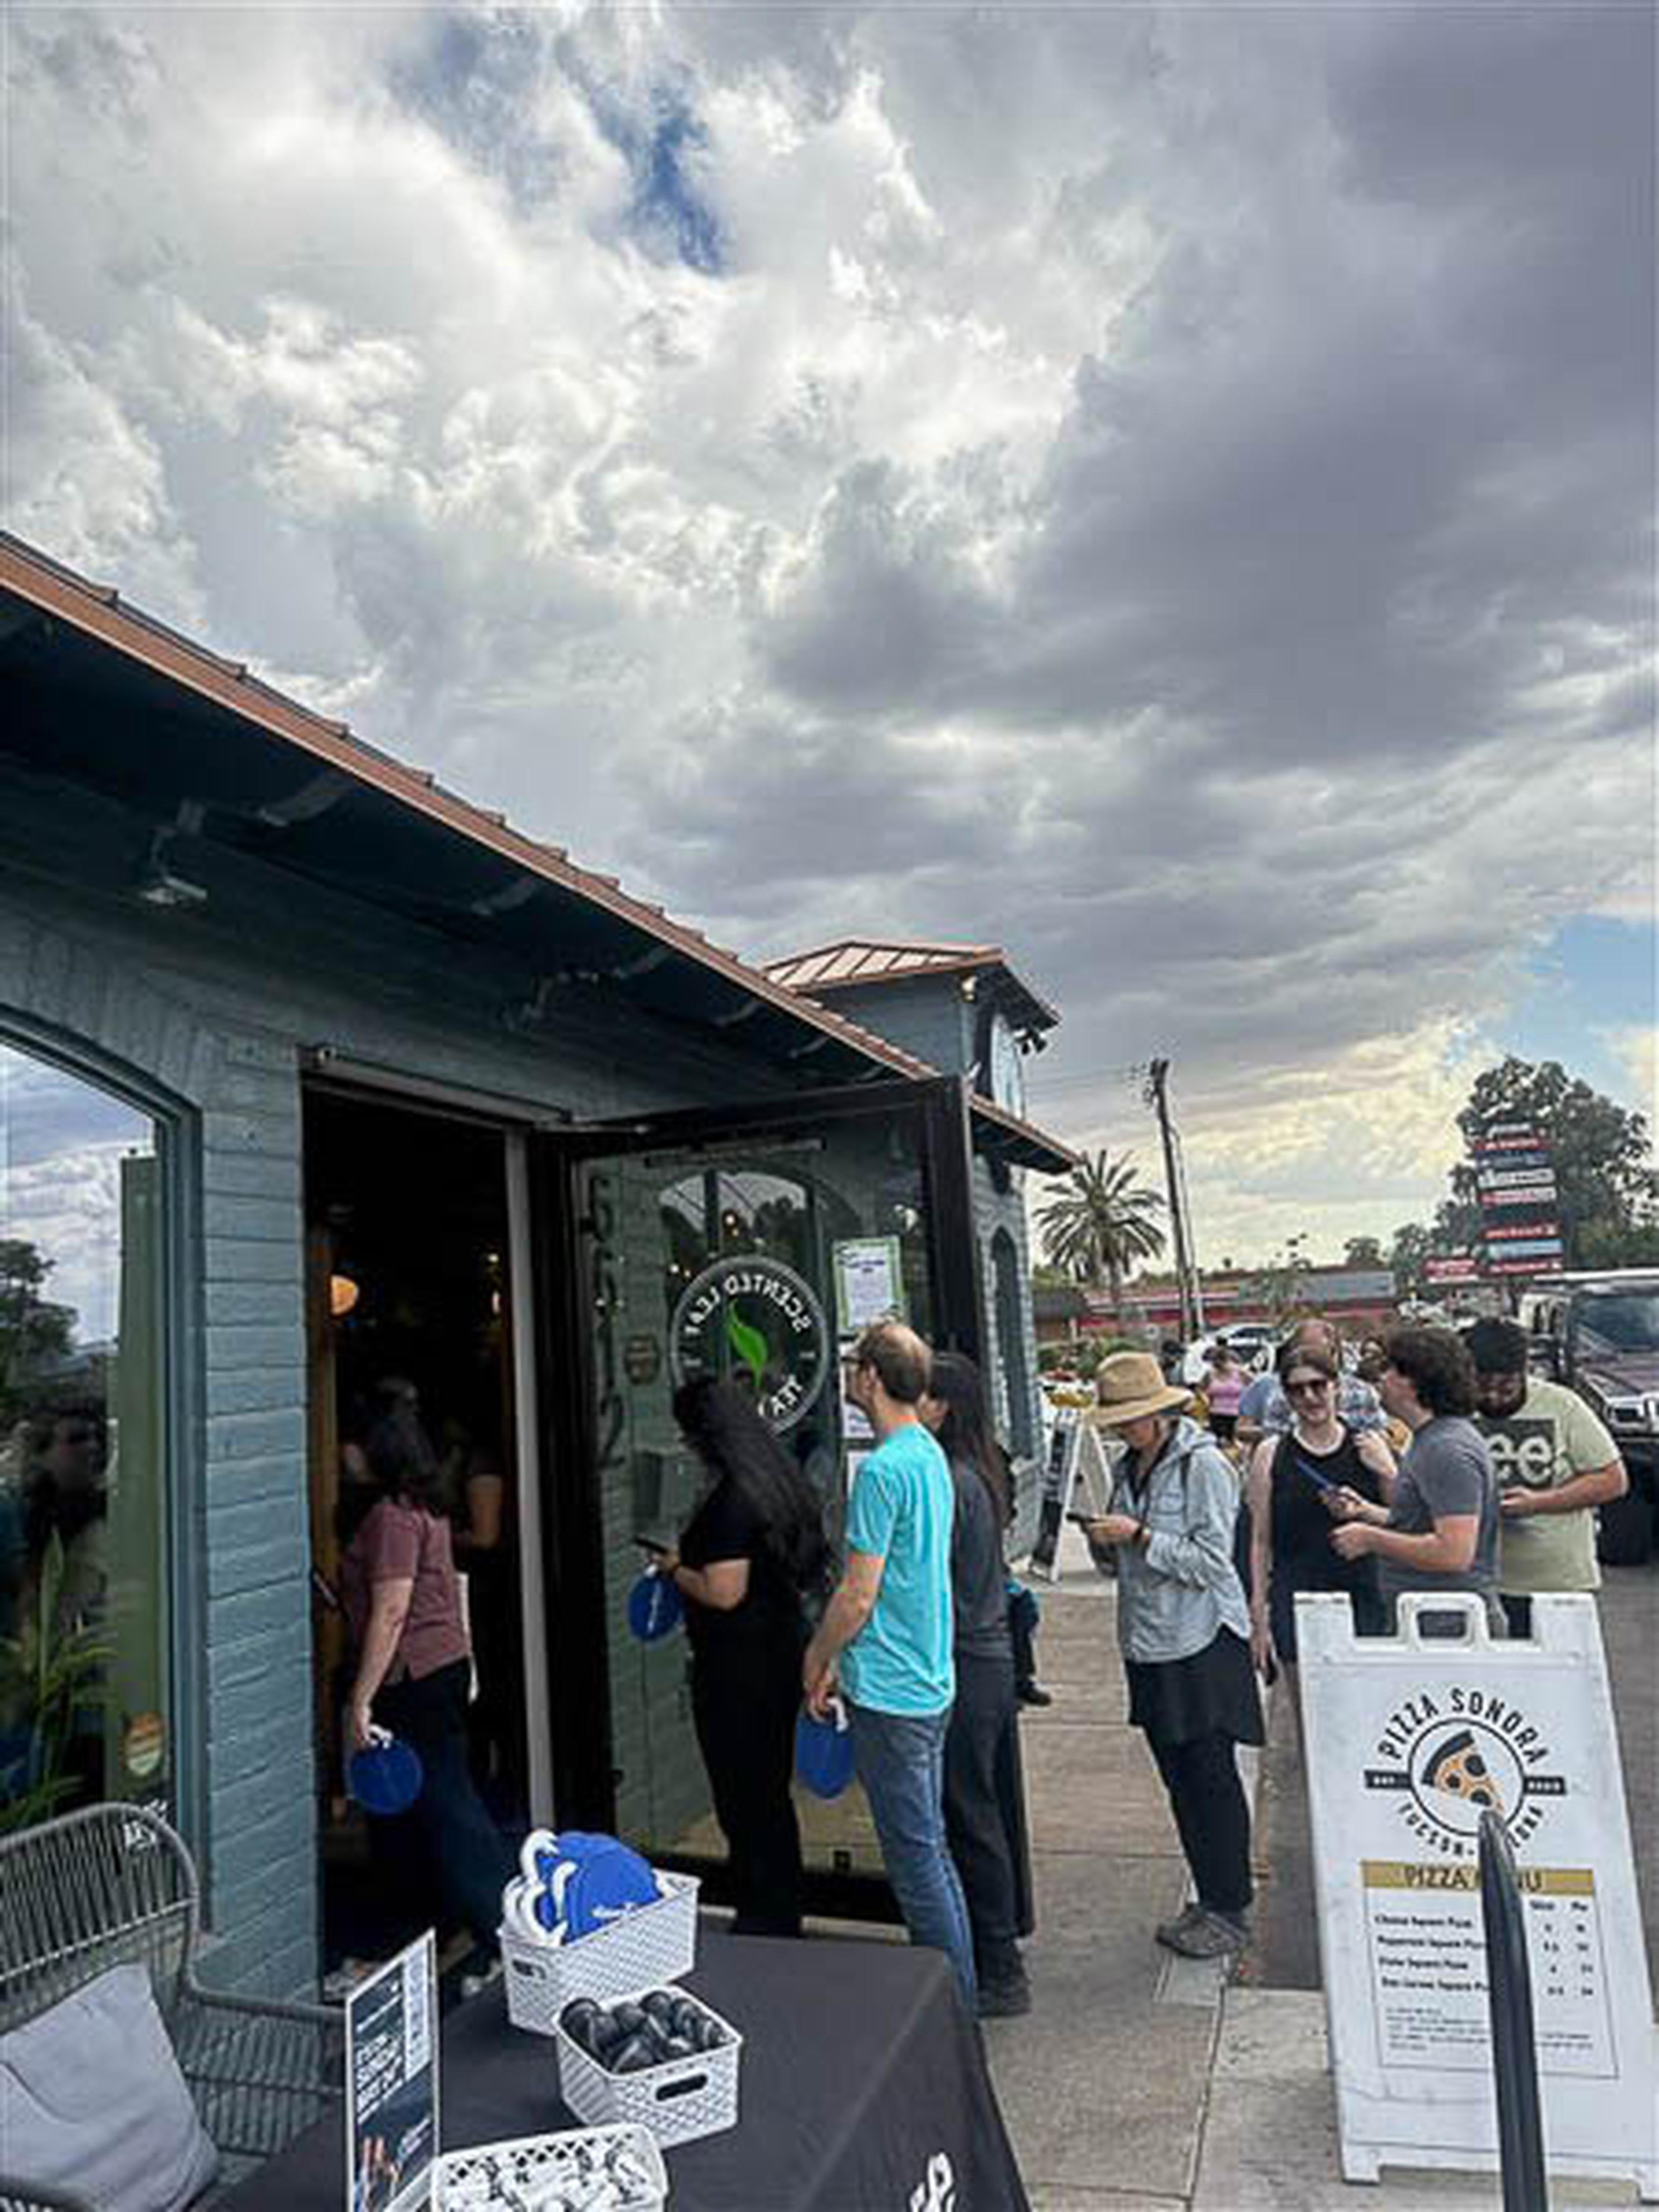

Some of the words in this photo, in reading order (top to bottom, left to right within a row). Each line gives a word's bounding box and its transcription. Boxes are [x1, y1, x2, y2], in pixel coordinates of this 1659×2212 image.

[1378, 1694, 1439, 1760] PIZZA
[1450, 1688, 1549, 1764] SONORA
[1404, 1864, 1469, 1889] PIZZA
